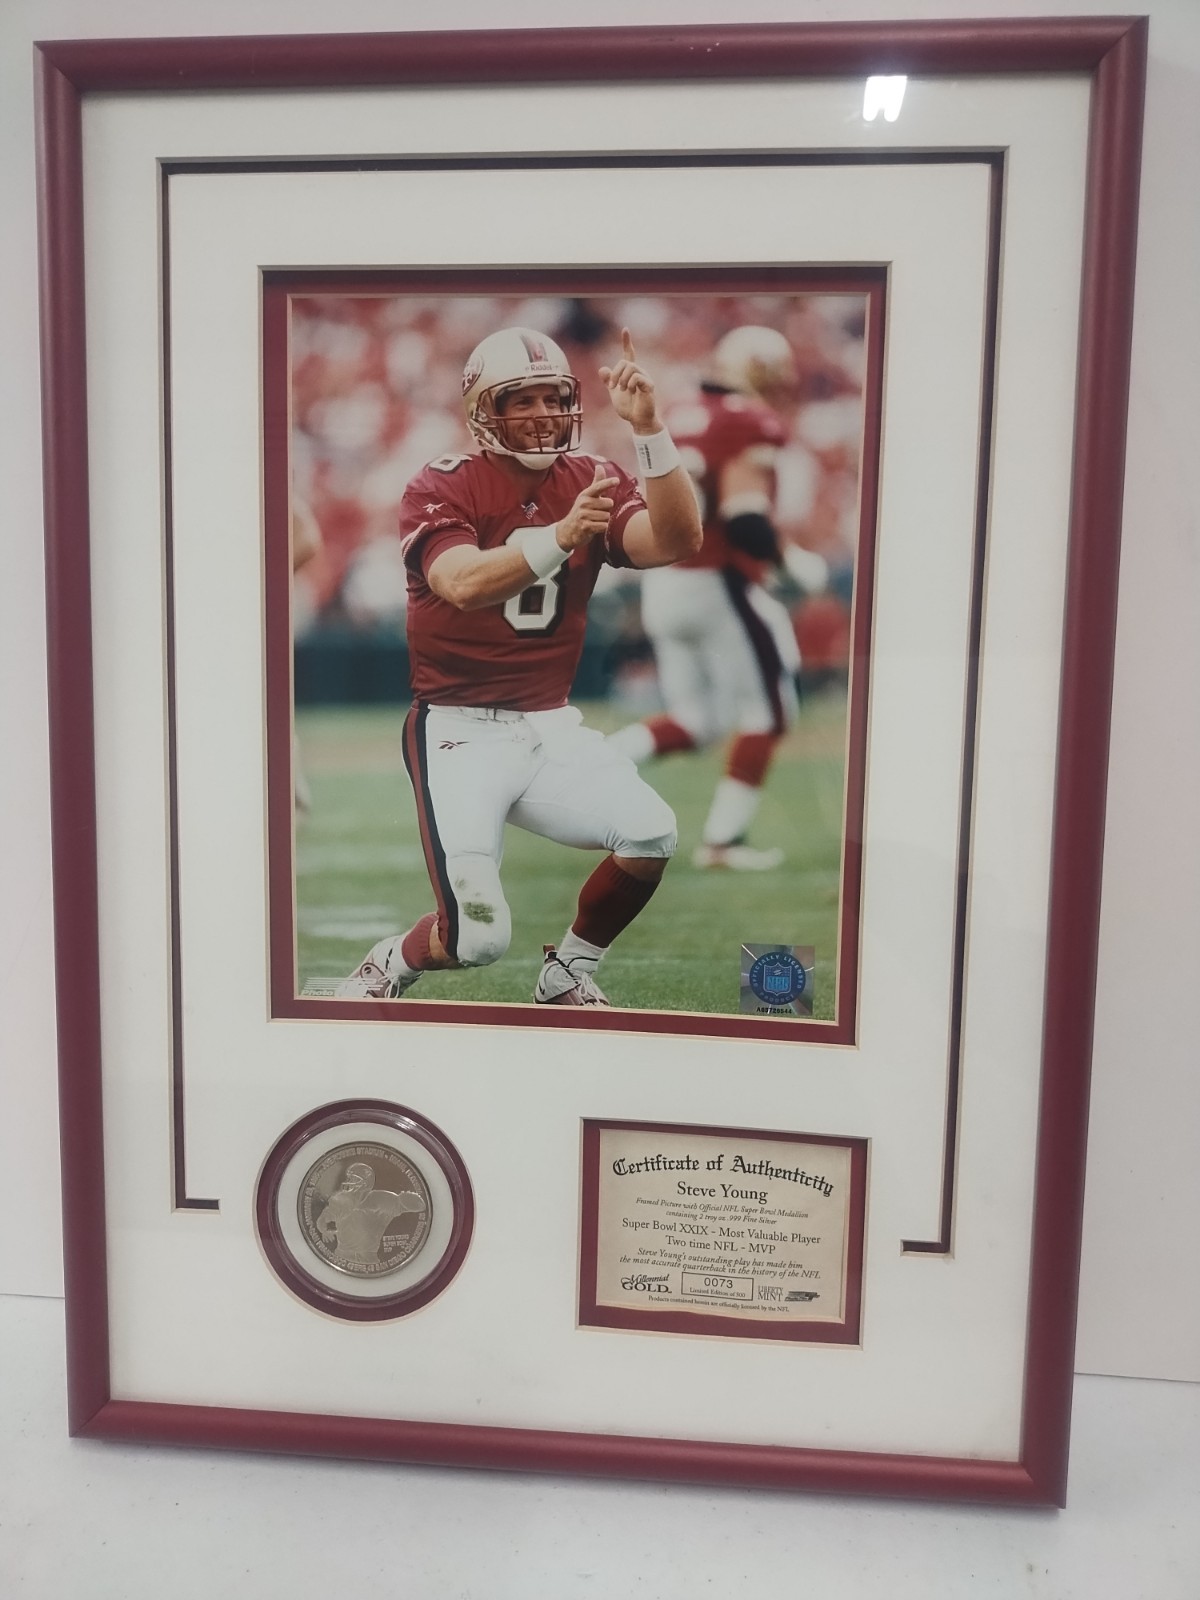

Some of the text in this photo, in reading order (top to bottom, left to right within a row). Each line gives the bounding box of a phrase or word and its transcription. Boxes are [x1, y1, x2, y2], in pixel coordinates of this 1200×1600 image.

[752, 955, 804, 989] OFFICIALLY LICENSED
[613, 1154, 834, 1197] Certificate of Authenticity
[677, 1180, 768, 1205] Steve Young
[636, 1197, 659, 1206] Framed
[660, 1199, 681, 1208] Picture
[683, 1201, 697, 1210] with
[699, 1203, 722, 1213] Official
[740, 1205, 759, 1215] Super
[760, 1207, 777, 1215] Bowl
[777, 1209, 809, 1218] Medallion
[666, 1210, 698, 1220] containing
[705, 1214, 718, 1222] troy
[758, 1217, 777, 1225] Silver
[622, 1217, 650, 1231] Super
[653, 1220, 677, 1232] Bowl
[679, 1223, 709, 1236] XXIX
[718, 1227, 745, 1238] Most
[747, 1228, 788, 1242] Valuable
[791, 1233, 821, 1246] Player
[665, 1235, 687, 1247] Two
[689, 1239, 711, 1250] time
[713, 1240, 738, 1252] NFL
[748, 1243, 776, 1254] MVP
[637, 1247, 803, 1269] Steve Young's outstanding play has made him
[619, 1255, 821, 1279] the most accurate quarterback in the history of the NFL
[621, 1274, 670, 1284] Millennial
[622, 1282, 671, 1293] GOLD
[704, 1277, 733, 1289] 0073
[689, 1287, 709, 1295] Limited
[757, 1285, 784, 1295] LIBERTY
[757, 1292, 782, 1302] MINT
[719, 1301, 740, 1309] officially
[761, 1304, 767, 1312] by
